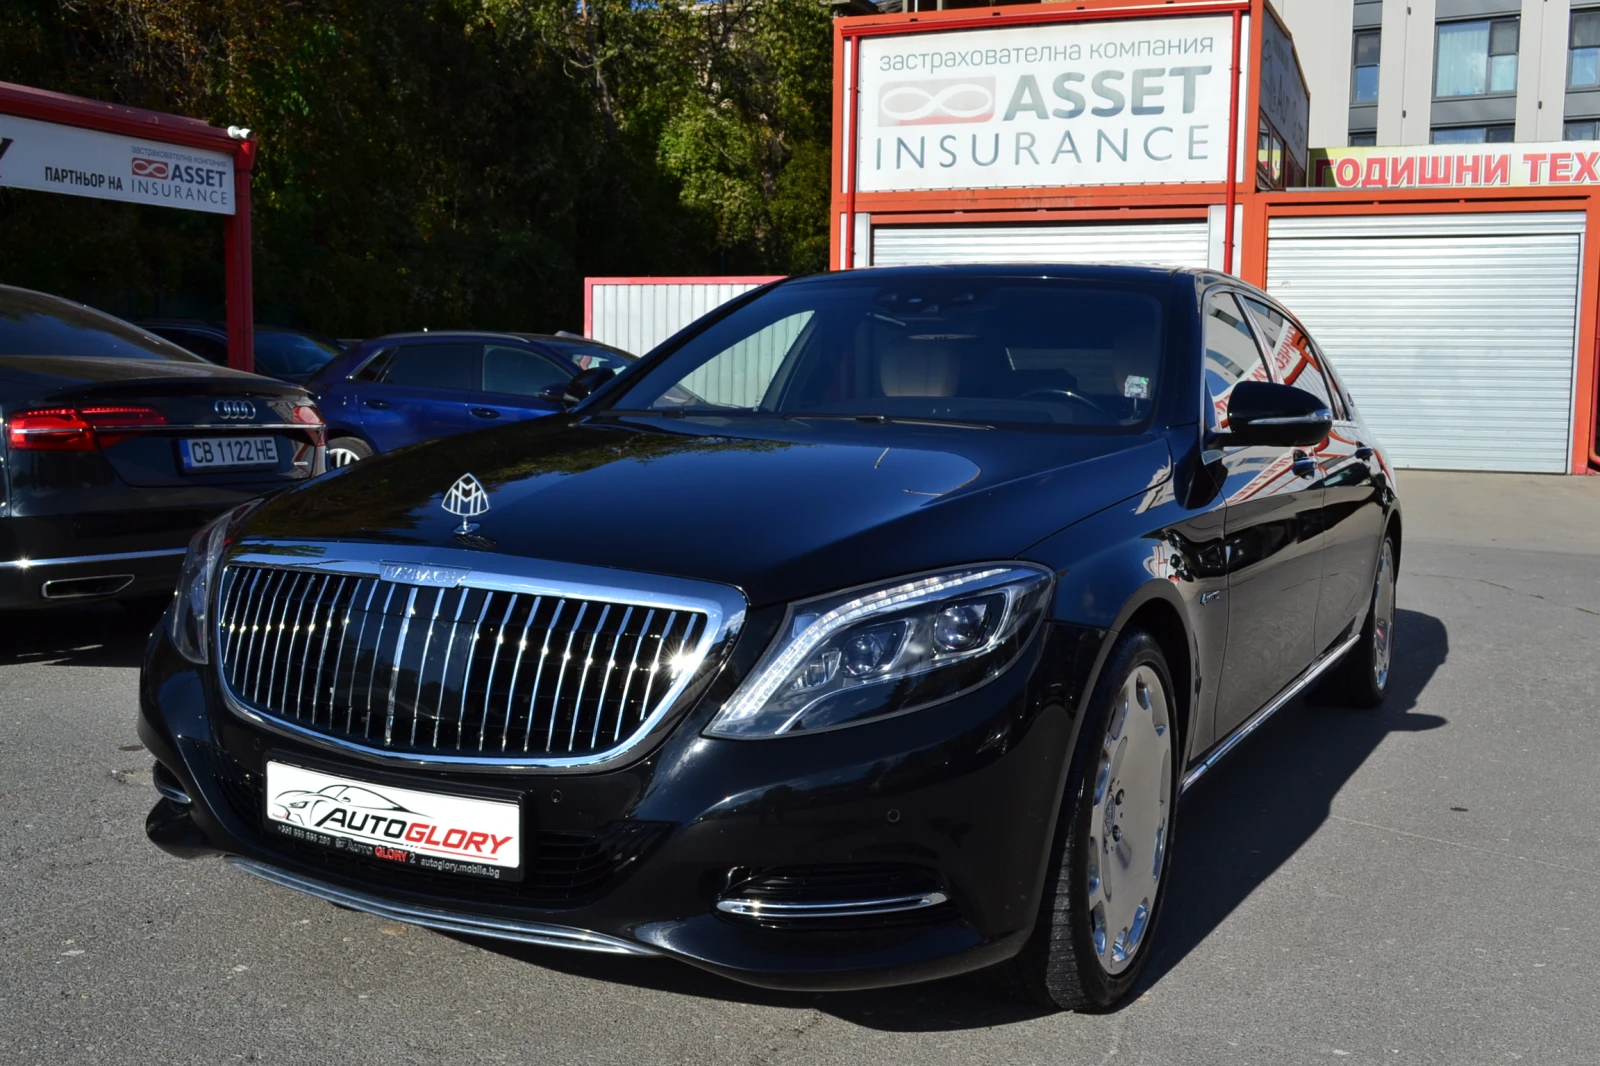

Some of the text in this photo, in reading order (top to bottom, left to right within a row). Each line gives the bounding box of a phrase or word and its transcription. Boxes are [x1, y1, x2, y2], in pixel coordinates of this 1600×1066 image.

[879, 35, 1214, 74] застрахователна компания
[1002, 64, 1213, 122] ASSET
[875, 124, 1210, 171] INSURANCE
[45, 166, 123, 192] ПАРТНЬОР НА
[171, 163, 227, 188] ASSET
[1314, 152, 1600, 188] ГОДИШНИ ТЕХ
[131, 178, 228, 206] INSURANCE
[217, 440, 254, 462] 1122
[374, 845, 408, 863] GLORY
[409, 853, 416, 864] 2
[420, 857, 500, 879] autoglory.mobile.bg
